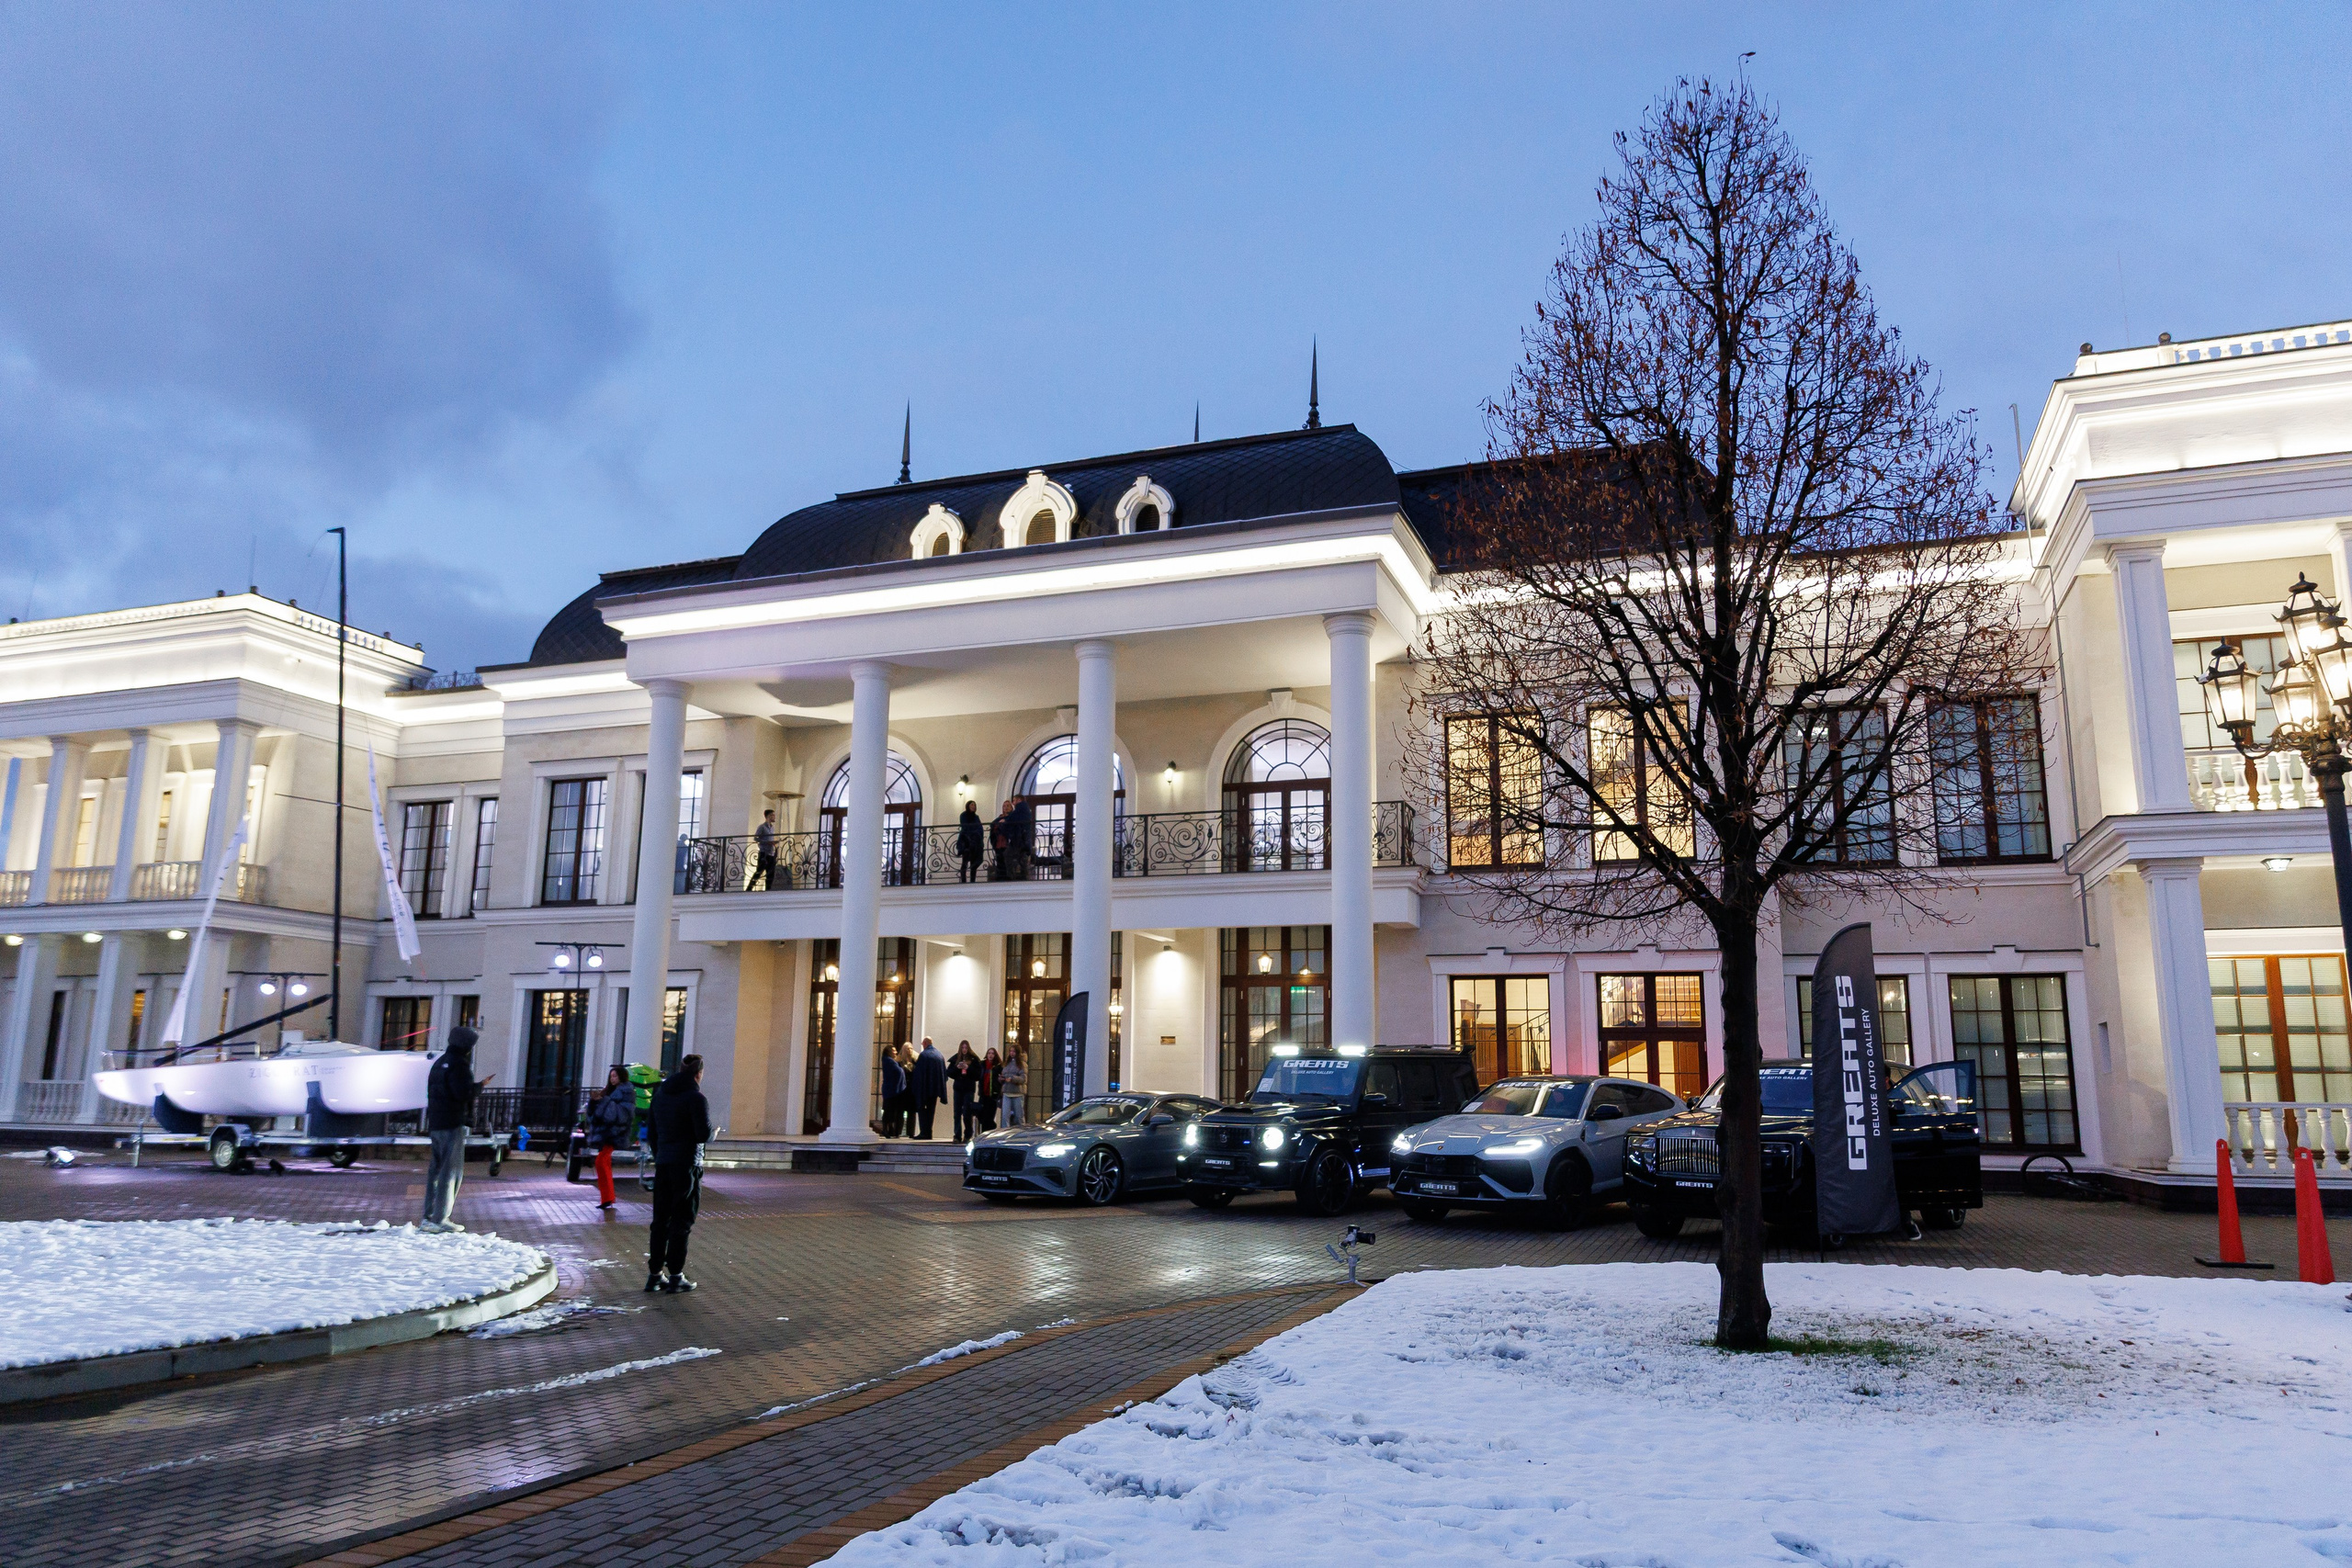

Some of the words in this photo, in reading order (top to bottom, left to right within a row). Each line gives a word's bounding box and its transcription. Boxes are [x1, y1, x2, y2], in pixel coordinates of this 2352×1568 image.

[1861, 1008, 1873, 1056] GALLERY
[1062, 1021, 1073, 1109] REATS
[1283, 1059, 1350, 1069] GREATS
[1835, 975, 1868, 1170] GREATS
[1867, 1060, 1878, 1089] AUTO
[1871, 1092, 1881, 1136] DELUXE
[1419, 1182, 1456, 1190] GREATS
